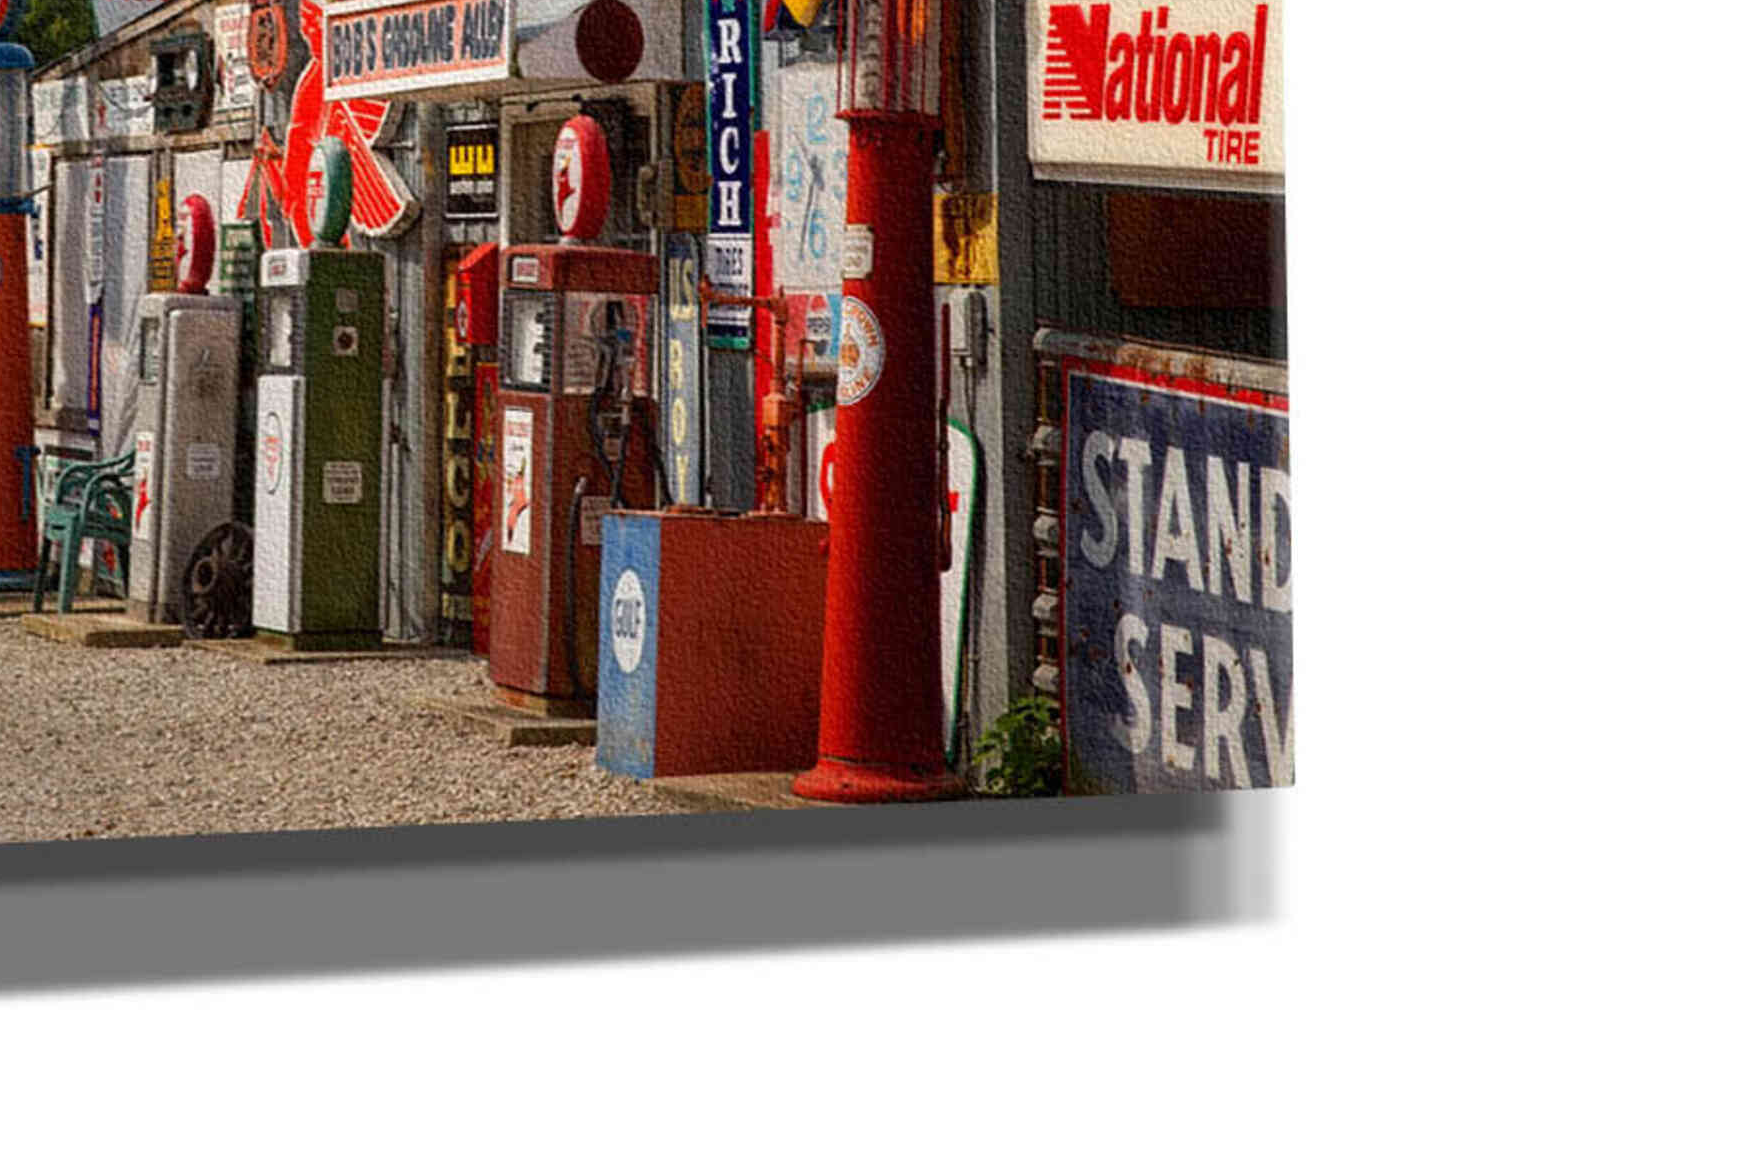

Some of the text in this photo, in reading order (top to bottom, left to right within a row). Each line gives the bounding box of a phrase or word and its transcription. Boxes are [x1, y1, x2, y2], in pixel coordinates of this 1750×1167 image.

[381, 4, 456, 70] GASOLINE
[1042, 3, 1269, 127] National
[449, 144, 495, 175] WU
[1203, 129, 1261, 165] TIRE
[1080, 429, 1292, 614] STAND
[1112, 614, 1296, 789] SERV
